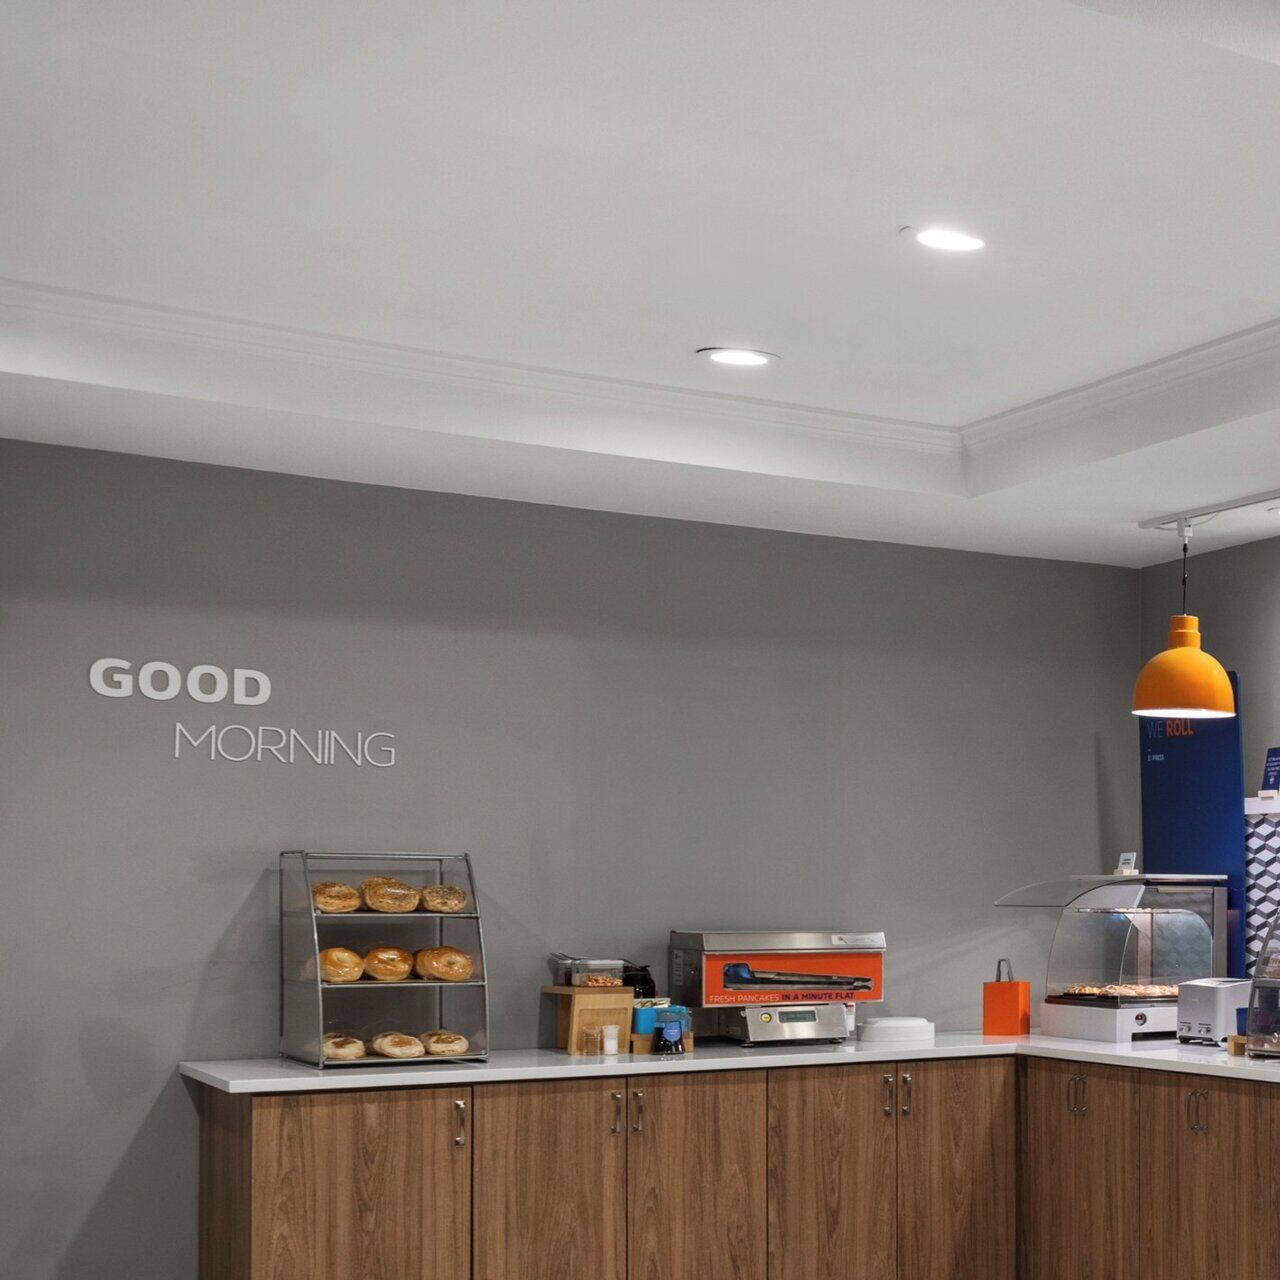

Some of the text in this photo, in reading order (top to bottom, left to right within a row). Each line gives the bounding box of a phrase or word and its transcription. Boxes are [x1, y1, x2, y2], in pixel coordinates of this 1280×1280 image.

[89, 657, 272, 706] GOOD
[1166, 719, 1194, 737] ROLL
[174, 722, 396, 768] MORNING
[709, 995, 736, 1003] FRESH
[737, 994, 780, 1002] PANCAKES
[801, 992, 833, 1000] MINUTE
[835, 991, 855, 999] FLAT
